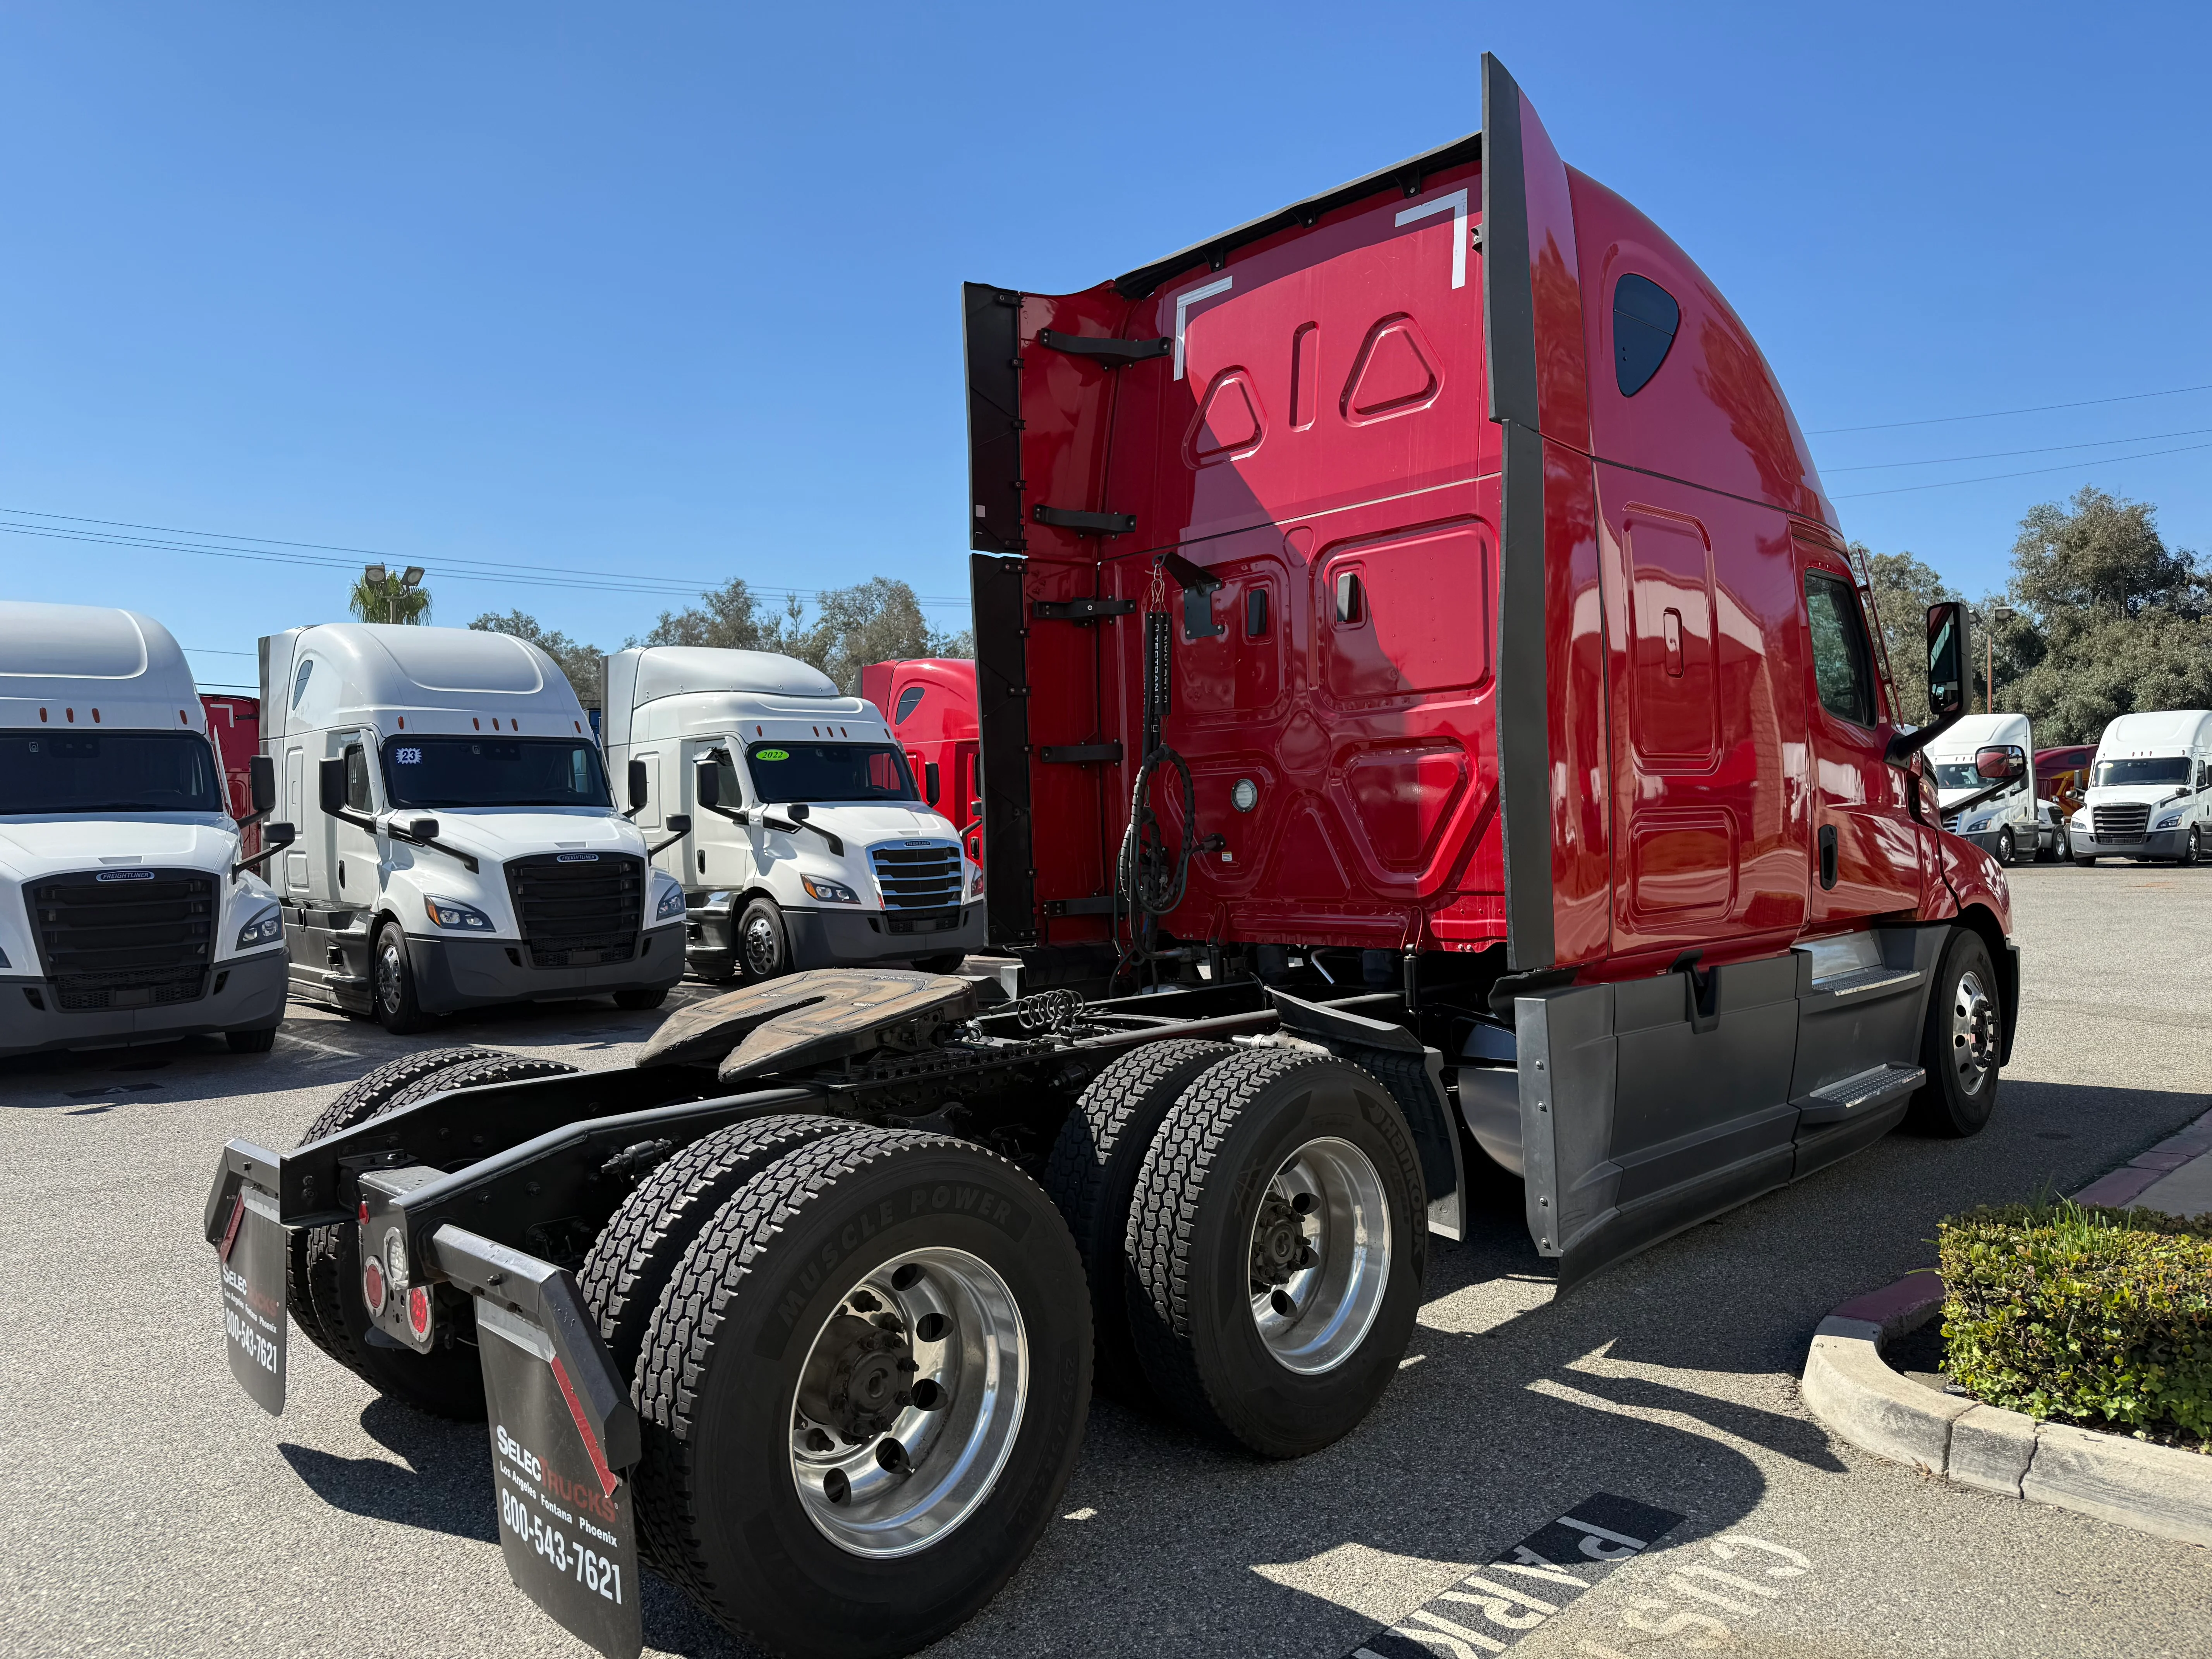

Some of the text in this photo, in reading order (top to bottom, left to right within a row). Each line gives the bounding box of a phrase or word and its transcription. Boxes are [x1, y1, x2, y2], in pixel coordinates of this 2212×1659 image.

[402, 750, 415, 761] 23
[777, 1185, 1013, 1328] MUSCLE POWER
[226, 1307, 277, 1374] 800-543-7621
[259, 1316, 277, 1334] Phoenix
[500, 1460, 618, 1548] Los Angeles Fontana Phoenix
[502, 1487, 622, 1605] 800-543-7621
